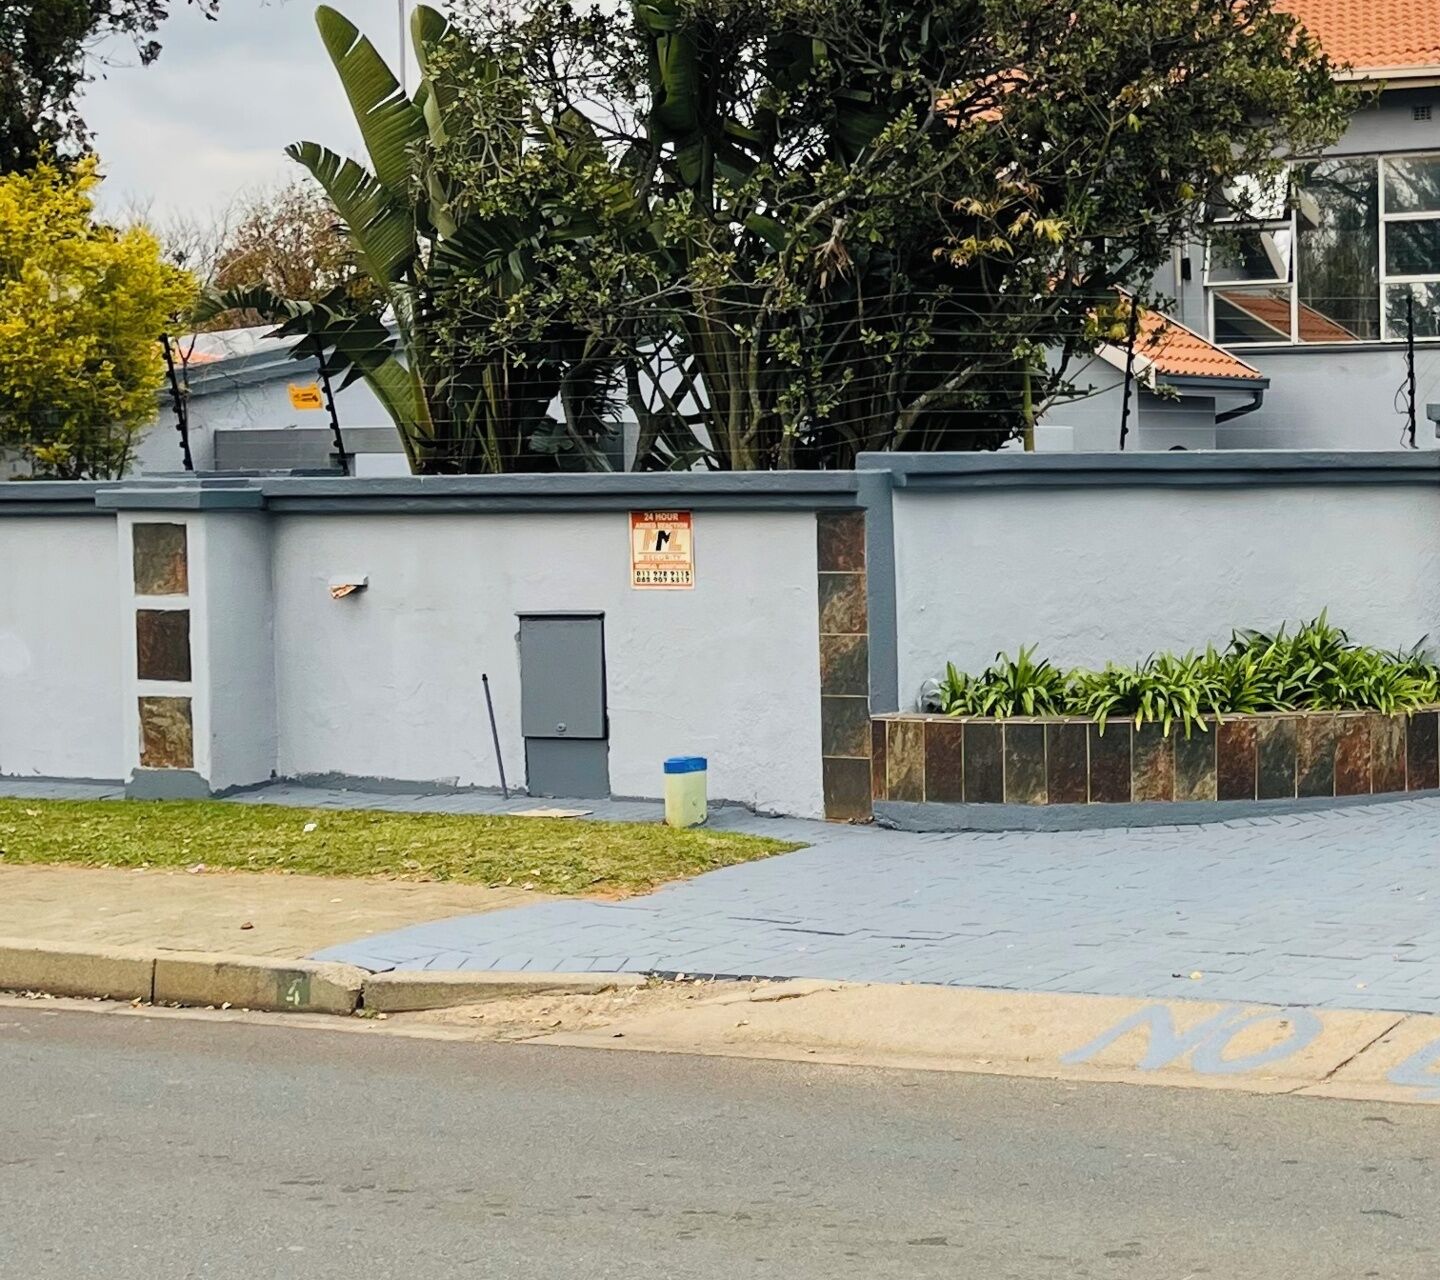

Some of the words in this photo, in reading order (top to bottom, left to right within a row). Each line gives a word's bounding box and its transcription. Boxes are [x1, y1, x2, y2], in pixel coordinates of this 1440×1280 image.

[644, 513, 654, 521] 24
[655, 513, 679, 521] HOUR
[1062, 1004, 1324, 1075] NO
